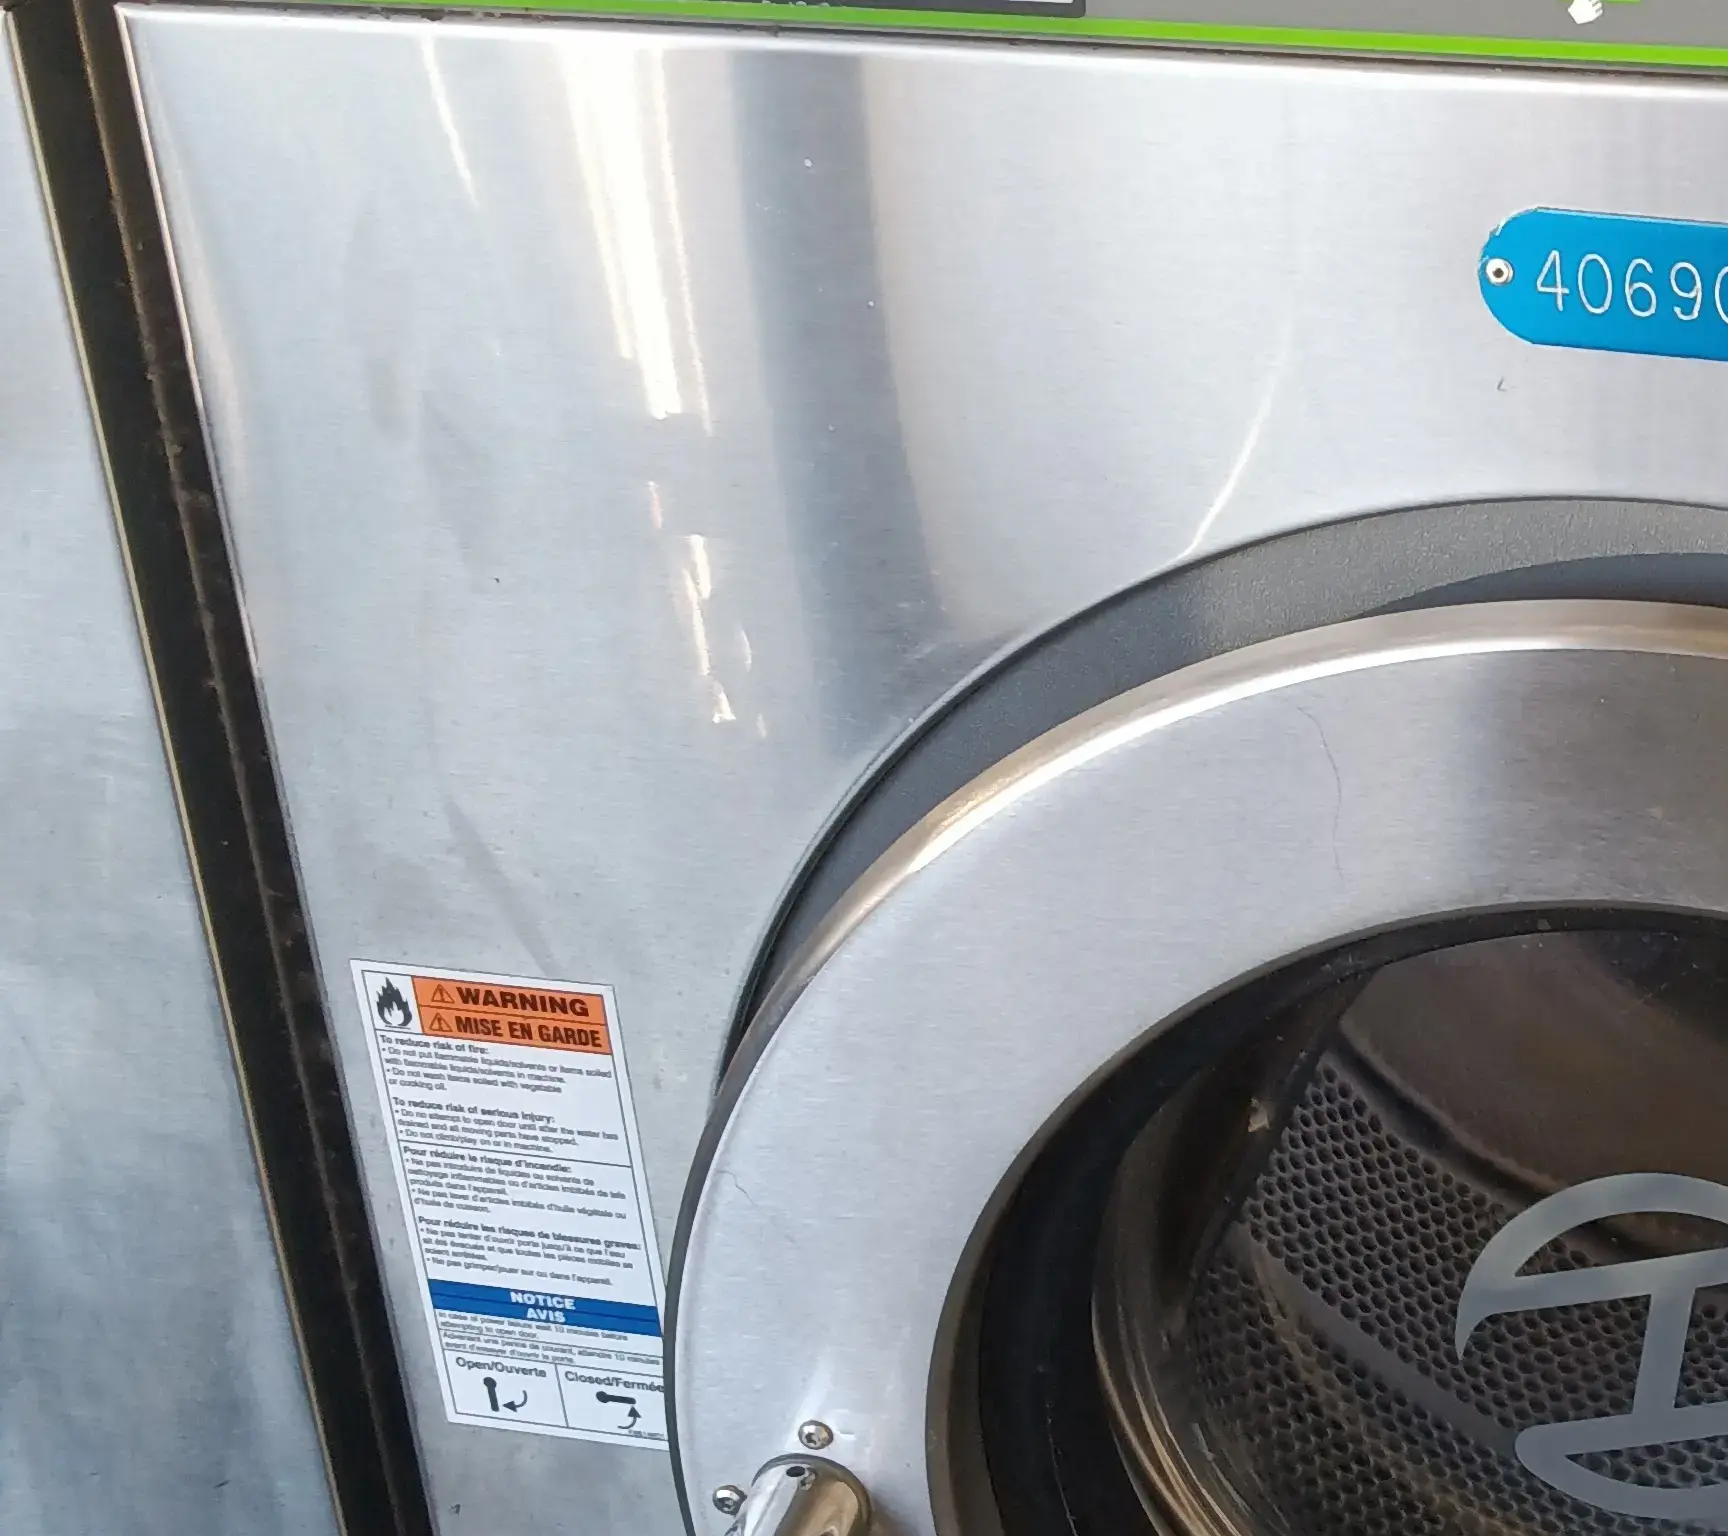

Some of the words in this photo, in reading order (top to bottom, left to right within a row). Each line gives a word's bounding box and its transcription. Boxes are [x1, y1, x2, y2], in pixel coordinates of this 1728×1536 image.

[456, 986, 589, 1016] WARNING
[454, 1015, 503, 1037] MISE
[507, 1021, 533, 1040] EN
[536, 1024, 602, 1047] GARDE
[379, 1034, 393, 1044] To
[394, 1036, 431, 1048] reduce
[432, 1040, 453, 1051] risk
[454, 1042, 465, 1052] of
[392, 1096, 406, 1107] To
[407, 1098, 443, 1111] reduce
[444, 1102, 465, 1114] risk
[466, 1105, 479, 1115] of
[509, 1291, 576, 1310] NOTICE
[524, 1307, 566, 1323] AVIS
[454, 1355, 547, 1379] Open/Ouverte
